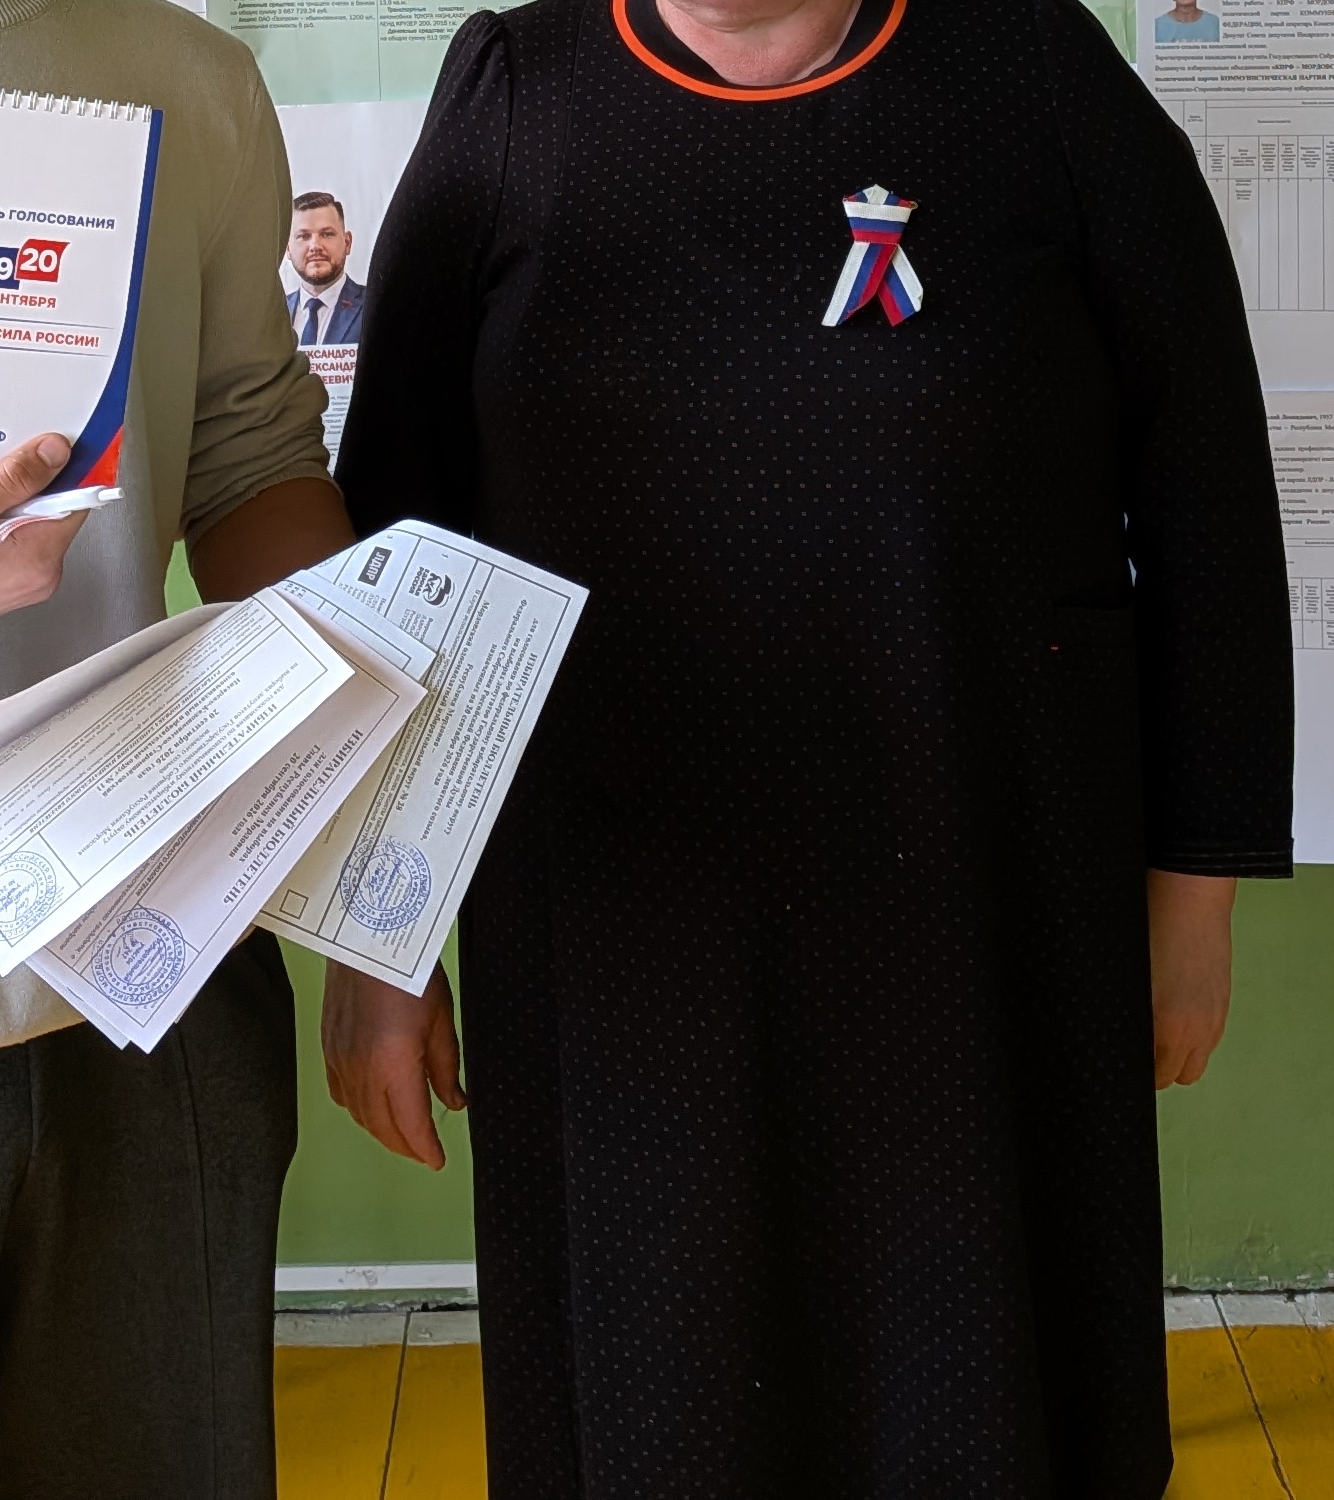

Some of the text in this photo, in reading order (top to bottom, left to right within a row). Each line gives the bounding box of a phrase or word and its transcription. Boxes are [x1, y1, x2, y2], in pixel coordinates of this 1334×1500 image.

[8, 209, 115, 230] ГОЛОСОВАНИЯ
[20, 249, 57, 273] 20
[35, 332, 99, 347] РОССИИ!
[307, 349, 356, 360] КСАНДРО
[310, 362, 356, 372] ЕКСАНДР
[322, 375, 355, 385] ЕЕВИЧ
[364, 551, 385, 581] ЛДПР
[408, 566, 423, 594] РОССИЯ
[173, 717, 209, 749] сентября
[466, 653, 537, 809] ИЗБИРАТЕЛЬНЫЙ БЮЛЛЕТЕНЬ
[155, 748, 173, 764] 2026
[297, 744, 320, 771] Главы
[122, 703, 277, 839] ИЗБИРАТЕЛЬНЫЙ БЮЛЛЕТЕНЬ
[136, 763, 155, 779] года
[231, 752, 300, 835] 20 сентября 2026 года
[260, 769, 300, 818] Республики
[222, 728, 363, 906] ИЗБИРАТЕЛЬНЫЙ БЮЛЛЕТЕНЬ
[237, 752, 326, 864] для голосования на выборах
